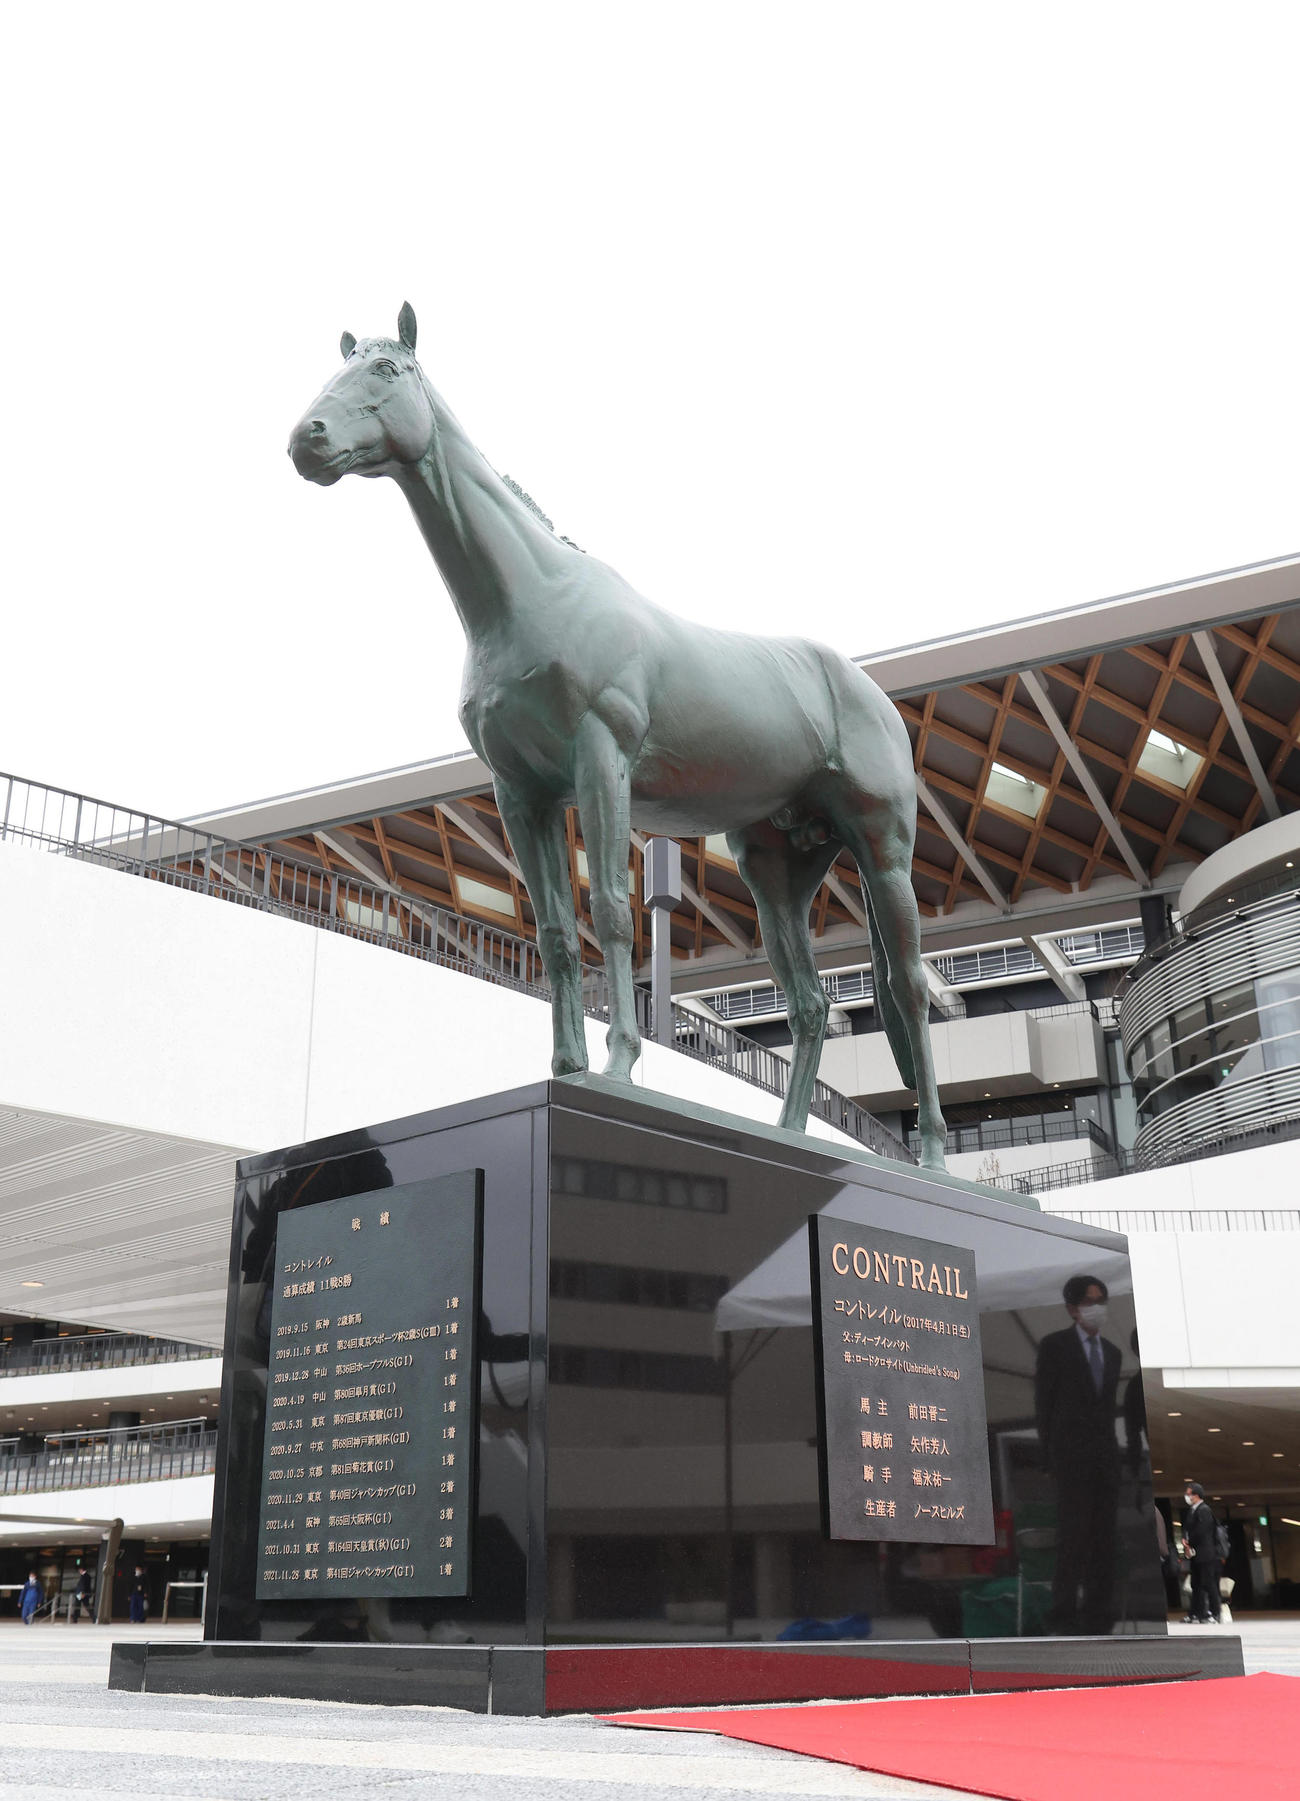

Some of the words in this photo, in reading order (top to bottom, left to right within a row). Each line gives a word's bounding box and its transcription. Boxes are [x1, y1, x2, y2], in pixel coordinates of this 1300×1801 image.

[285, 1256, 332, 1272] コントレイル
[833, 1243, 968, 1301] CONTRAIL
[283, 1281, 315, 1297] 通算成績
[321, 1274, 351, 1290] 11戦8勝
[277, 1323, 308, 1336] 2019.9.15
[316, 1318, 329, 1330] 阪神
[338, 1313, 361, 1326] 2歳新馬
[447, 1297, 458, 1308] 1着
[835, 1300, 901, 1324] コントレイル
[904, 1315, 970, 1338] (2017年4月1日生)
[276, 1346, 310, 1359] 2019.11.16
[315, 1343, 328, 1355] 東京
[446, 1322, 458, 1334] 1着
[275, 1370, 309, 1383] 2019.12.28
[314, 1368, 327, 1378] 中山
[445, 1348, 457, 1360] 1着
[943, 1367, 960, 1380] Song)
[273, 1395, 304, 1407] 2020.4.19
[313, 1392, 326, 1402] 中山
[445, 1373, 456, 1386] 1着
[272, 1419, 302, 1431] 2020.5.31
[311, 1416, 325, 1428] 東京
[444, 1400, 456, 1412] 1着
[909, 1403, 947, 1421] 前田晋二
[271, 1444, 302, 1455] 2020.9.27
[310, 1441, 323, 1452] 中京
[443, 1426, 455, 1438] 1着
[861, 1431, 892, 1450] 調教師
[911, 1436, 949, 1455] 矢作芳人
[269, 1468, 304, 1480] 2020.10.25
[308, 1466, 322, 1478] 京都
[442, 1453, 454, 1466] 1着
[912, 1469, 951, 1487] 福永祐一
[268, 1493, 302, 1504] 2020.11.29
[307, 1491, 321, 1503] 東京
[441, 1481, 454, 1493] 2着
[266, 1520, 294, 1529] 2021.4.4
[306, 1517, 320, 1528] 阪神
[440, 1508, 453, 1520] 3着
[866, 1498, 896, 1517] 生産者
[915, 1504, 964, 1519] ノースヒルズ
[265, 1544, 299, 1554] 2021.10.31
[305, 1542, 319, 1553] 東京
[440, 1536, 453, 1548] 2着
[264, 1570, 299, 1580] 2021.11.28
[304, 1568, 318, 1580] 東京
[440, 1563, 452, 1575] 1着
